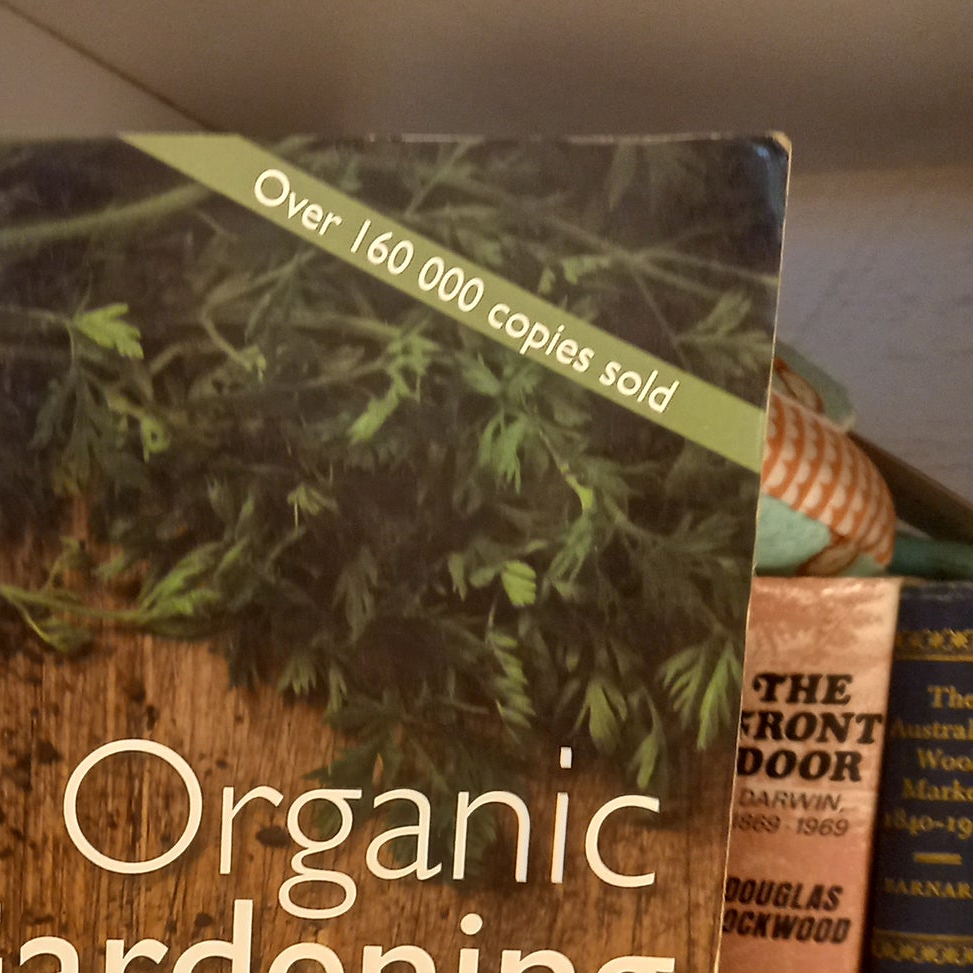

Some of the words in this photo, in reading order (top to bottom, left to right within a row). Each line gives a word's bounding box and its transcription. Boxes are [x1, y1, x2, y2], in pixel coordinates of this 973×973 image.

[254, 168, 343, 237] Over
[350, 218, 414, 275] 160
[418, 256, 485, 312] 000
[487, 303, 595, 373] copies
[598, 362, 681, 414] sold
[752, 672, 853, 706] THE
[737, 747, 863, 782] DOOR
[63, 738, 661, 920] Organic
[796, 817, 850, 837] 1969
[725, 876, 843, 911] DOUGLAS
